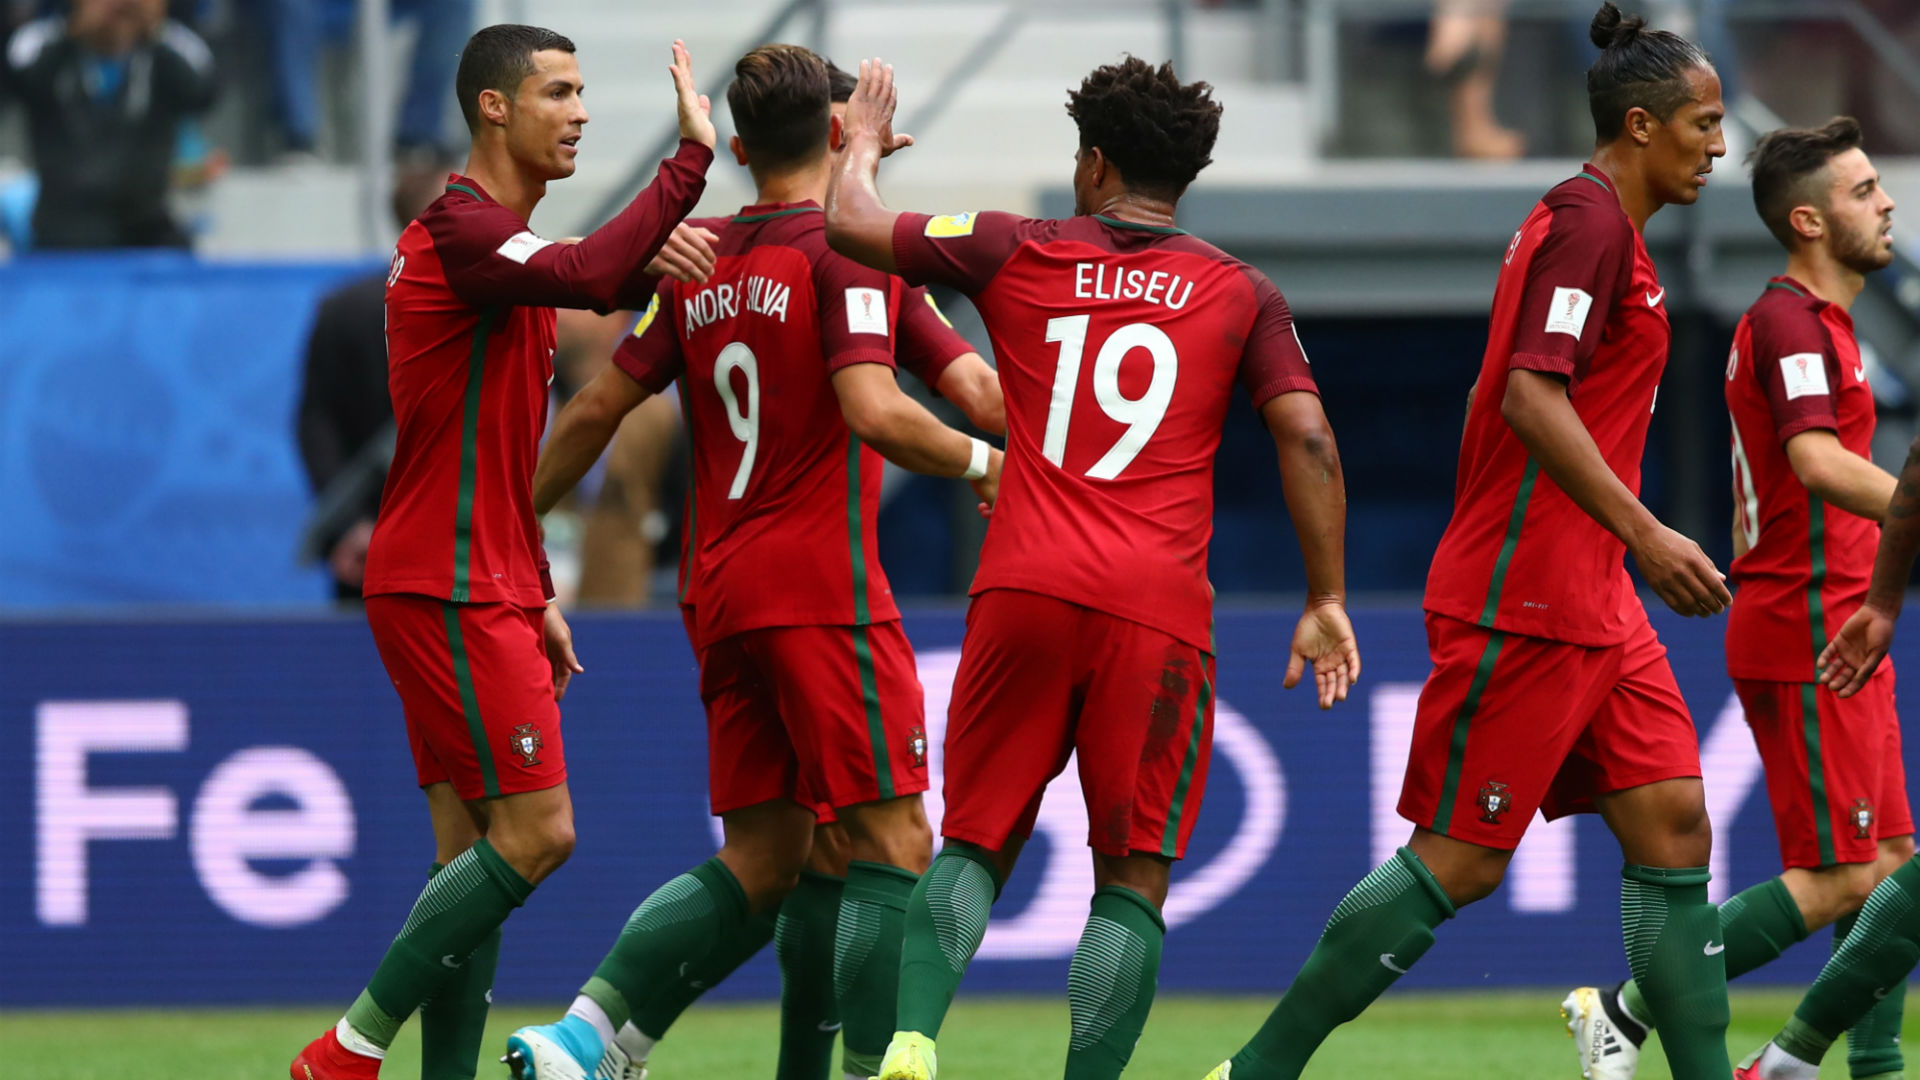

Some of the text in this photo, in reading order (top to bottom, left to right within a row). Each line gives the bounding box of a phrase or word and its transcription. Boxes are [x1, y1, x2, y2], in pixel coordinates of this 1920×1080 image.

[746, 275, 790, 323] SILVA
[1075, 262, 1195, 312] ELISEU
[714, 341, 760, 501] 9
[1041, 314, 1179, 481] 19
[1592, 1019, 1604, 1064] adidas
